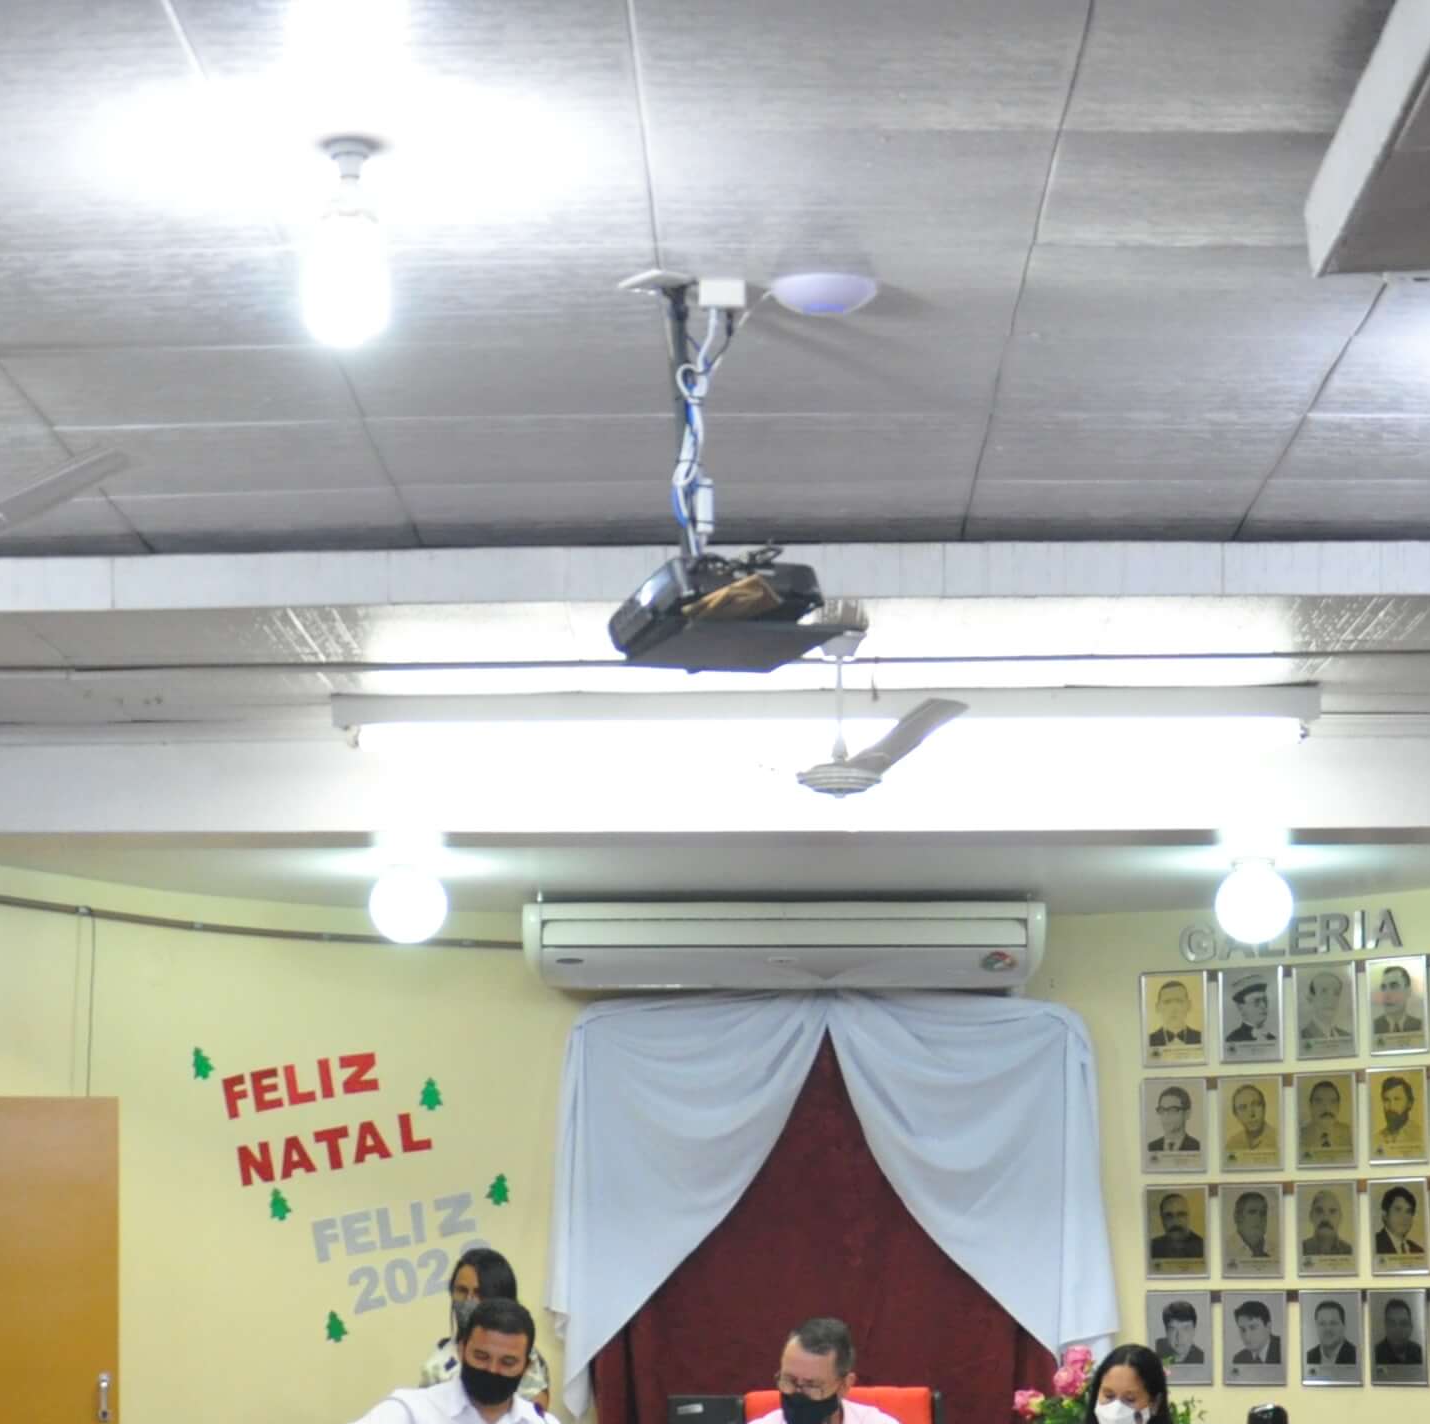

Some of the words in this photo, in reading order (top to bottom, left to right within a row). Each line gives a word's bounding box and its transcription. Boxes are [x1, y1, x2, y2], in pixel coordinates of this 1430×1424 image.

[222, 1052, 379, 1120] FELIZ
[237, 1113, 432, 1186] NATAL
[311, 1192, 476, 1263] FELIZ
